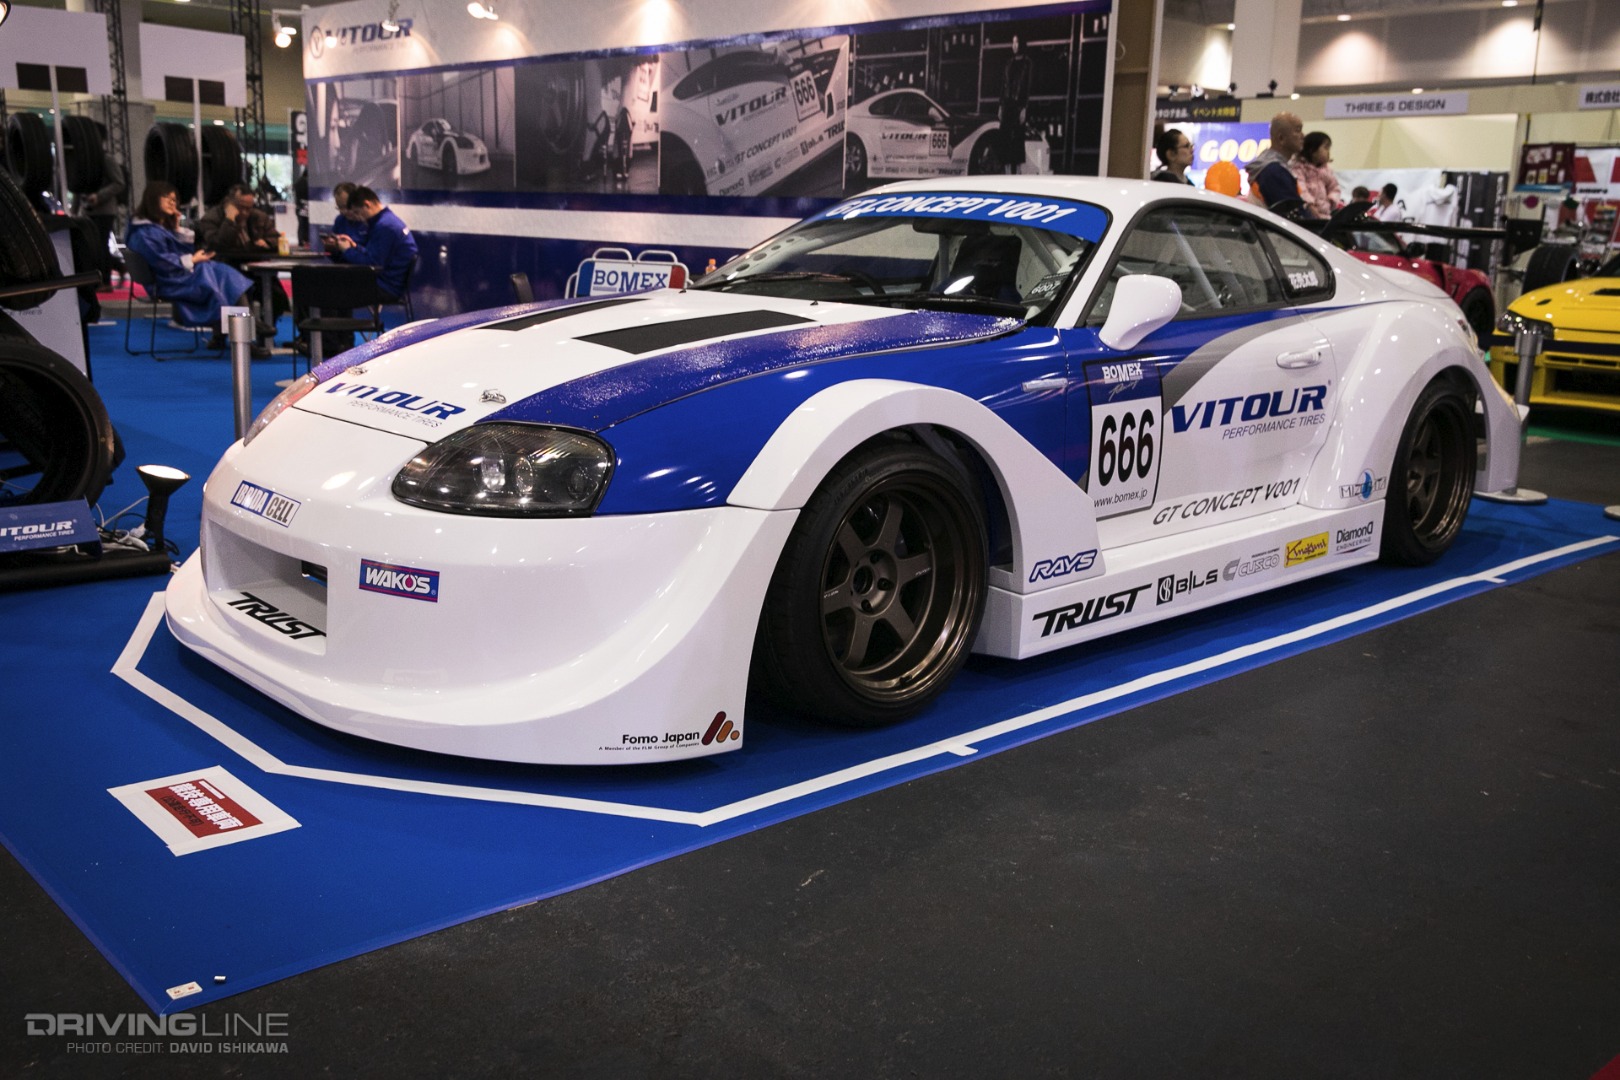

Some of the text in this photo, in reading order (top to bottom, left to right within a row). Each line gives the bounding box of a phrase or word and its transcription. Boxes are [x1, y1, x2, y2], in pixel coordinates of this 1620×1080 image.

[794, 76, 815, 106] 666
[1398, 99, 1446, 111] DESIGN
[715, 86, 787, 126] VITOUR
[931, 133, 948, 149] 666
[860, 196, 1003, 216] CONCEPT
[987, 200, 1077, 224] V001
[593, 269, 668, 292] BOMEX
[1102, 362, 1143, 382] BOMEX
[347, 400, 443, 428] PERFORMANCE TIRES
[1170, 385, 1327, 433] VITOUR
[1222, 413, 1325, 440] PERFORMANCE TIRES
[1098, 408, 1154, 487] 666
[266, 496, 294, 523] CELL
[1094, 488, 1148, 508] www.bomex.jp
[1153, 478, 1301, 525] GT CONCEPT V001
[14, 529, 75, 541] PERFORMANCE TIRES
[1029, 549, 1098, 583] RAYS
[1237, 553, 1280, 577] CUSCO
[365, 567, 431, 595] WAKO'S
[227, 591, 327, 640] TRUST
[1032, 583, 1153, 638] TRUST
[622, 731, 700, 746] Fomo Japan
